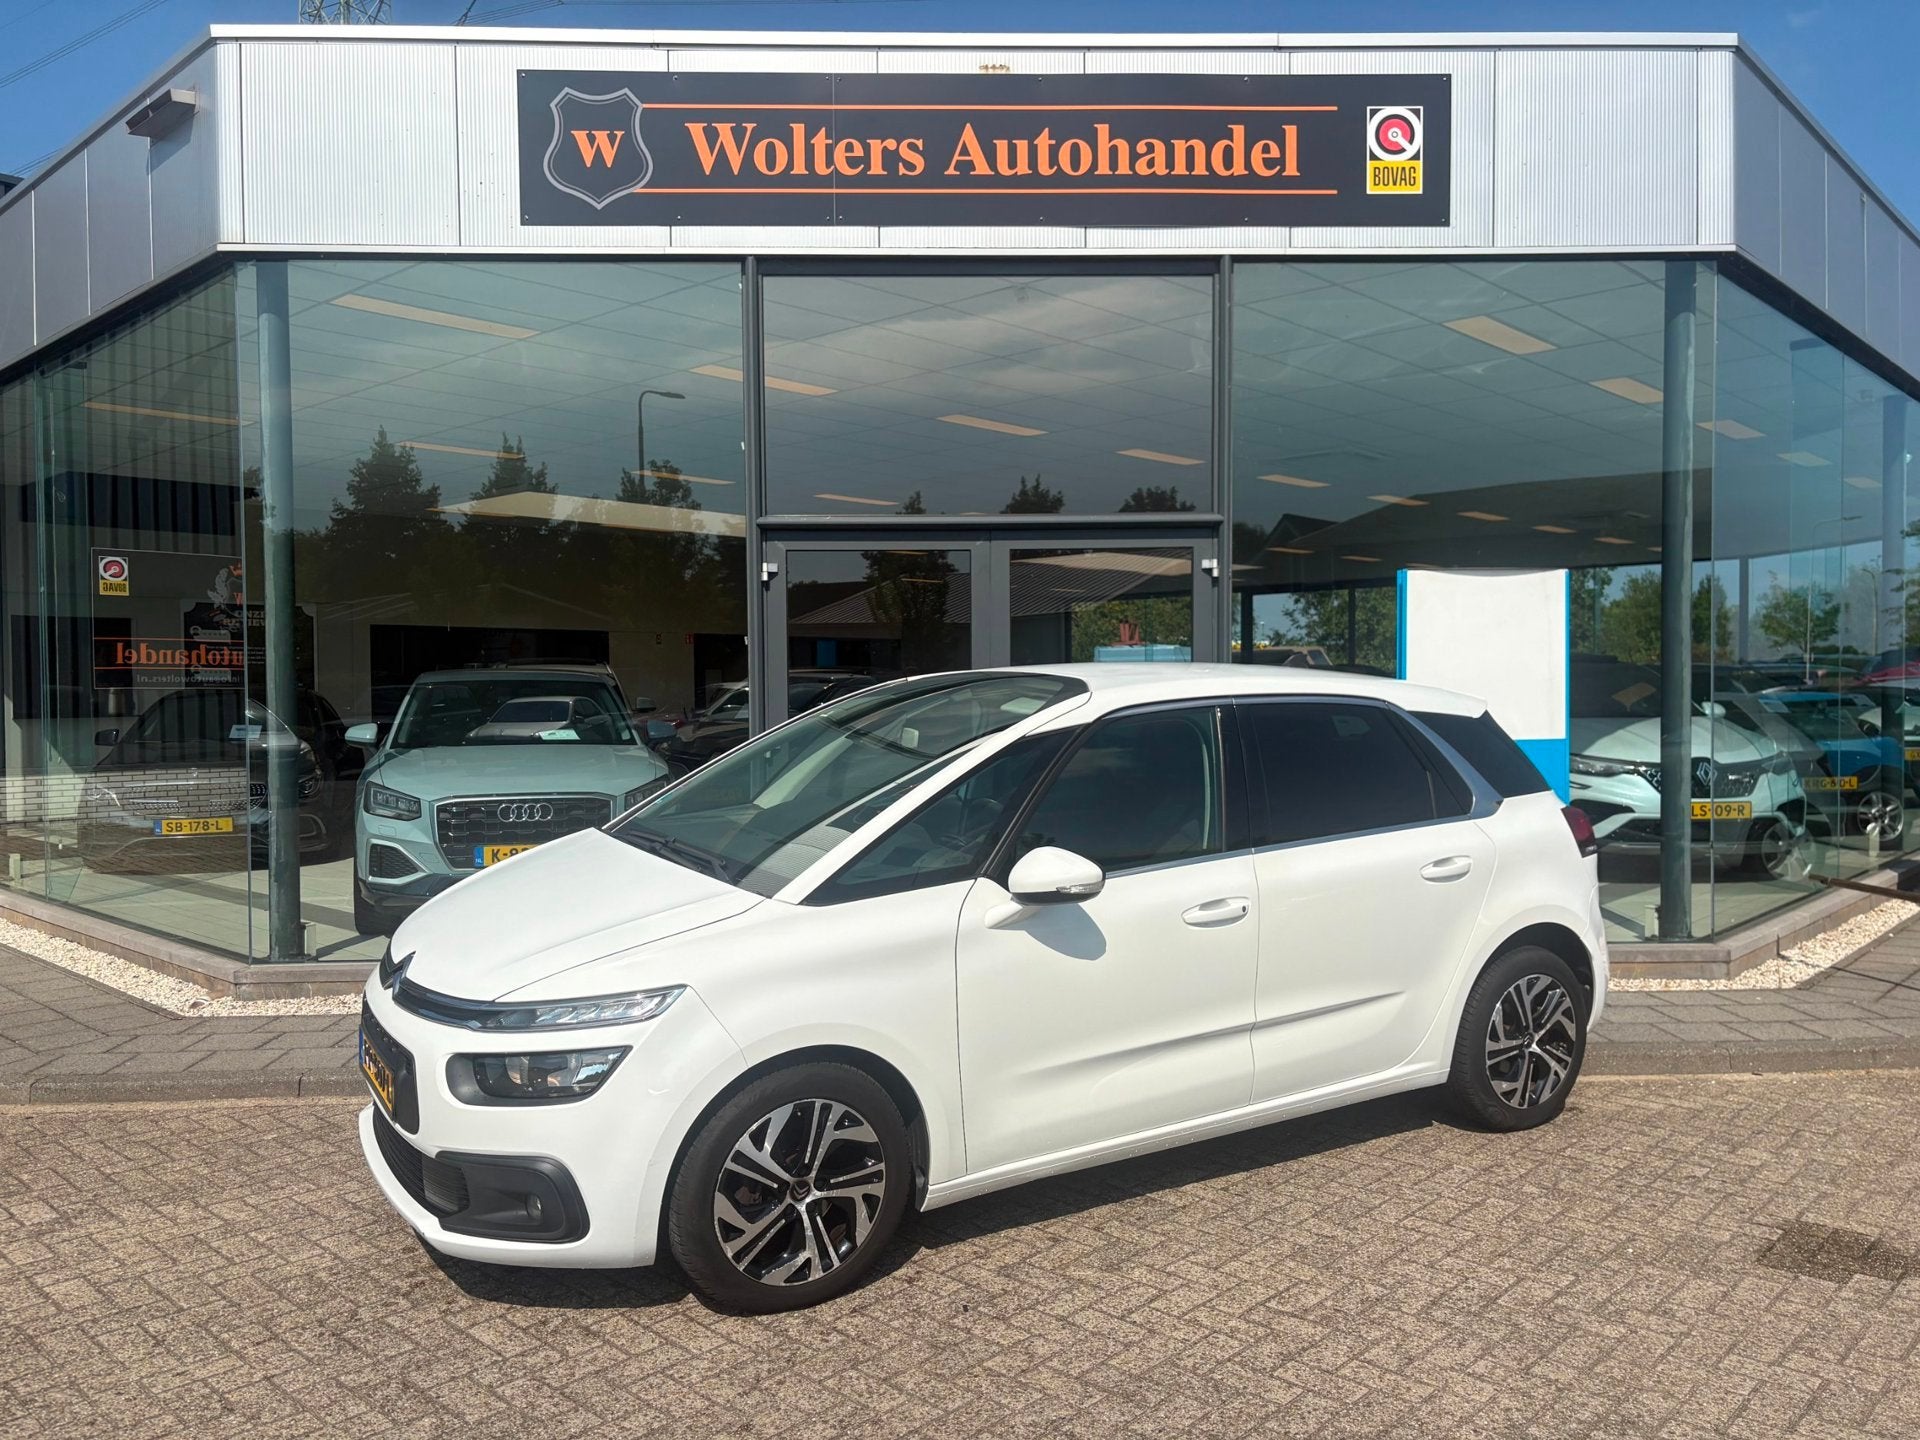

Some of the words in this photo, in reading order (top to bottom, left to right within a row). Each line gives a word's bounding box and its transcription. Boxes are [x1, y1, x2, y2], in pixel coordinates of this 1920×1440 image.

[571, 129, 625, 168] W
[684, 122, 925, 176] Wolters
[944, 122, 1301, 177] Autohandel
[1373, 166, 1417, 187] BOVAG
[166, 820, 223, 833] SB-178-L
[491, 847, 530, 864] K-8
